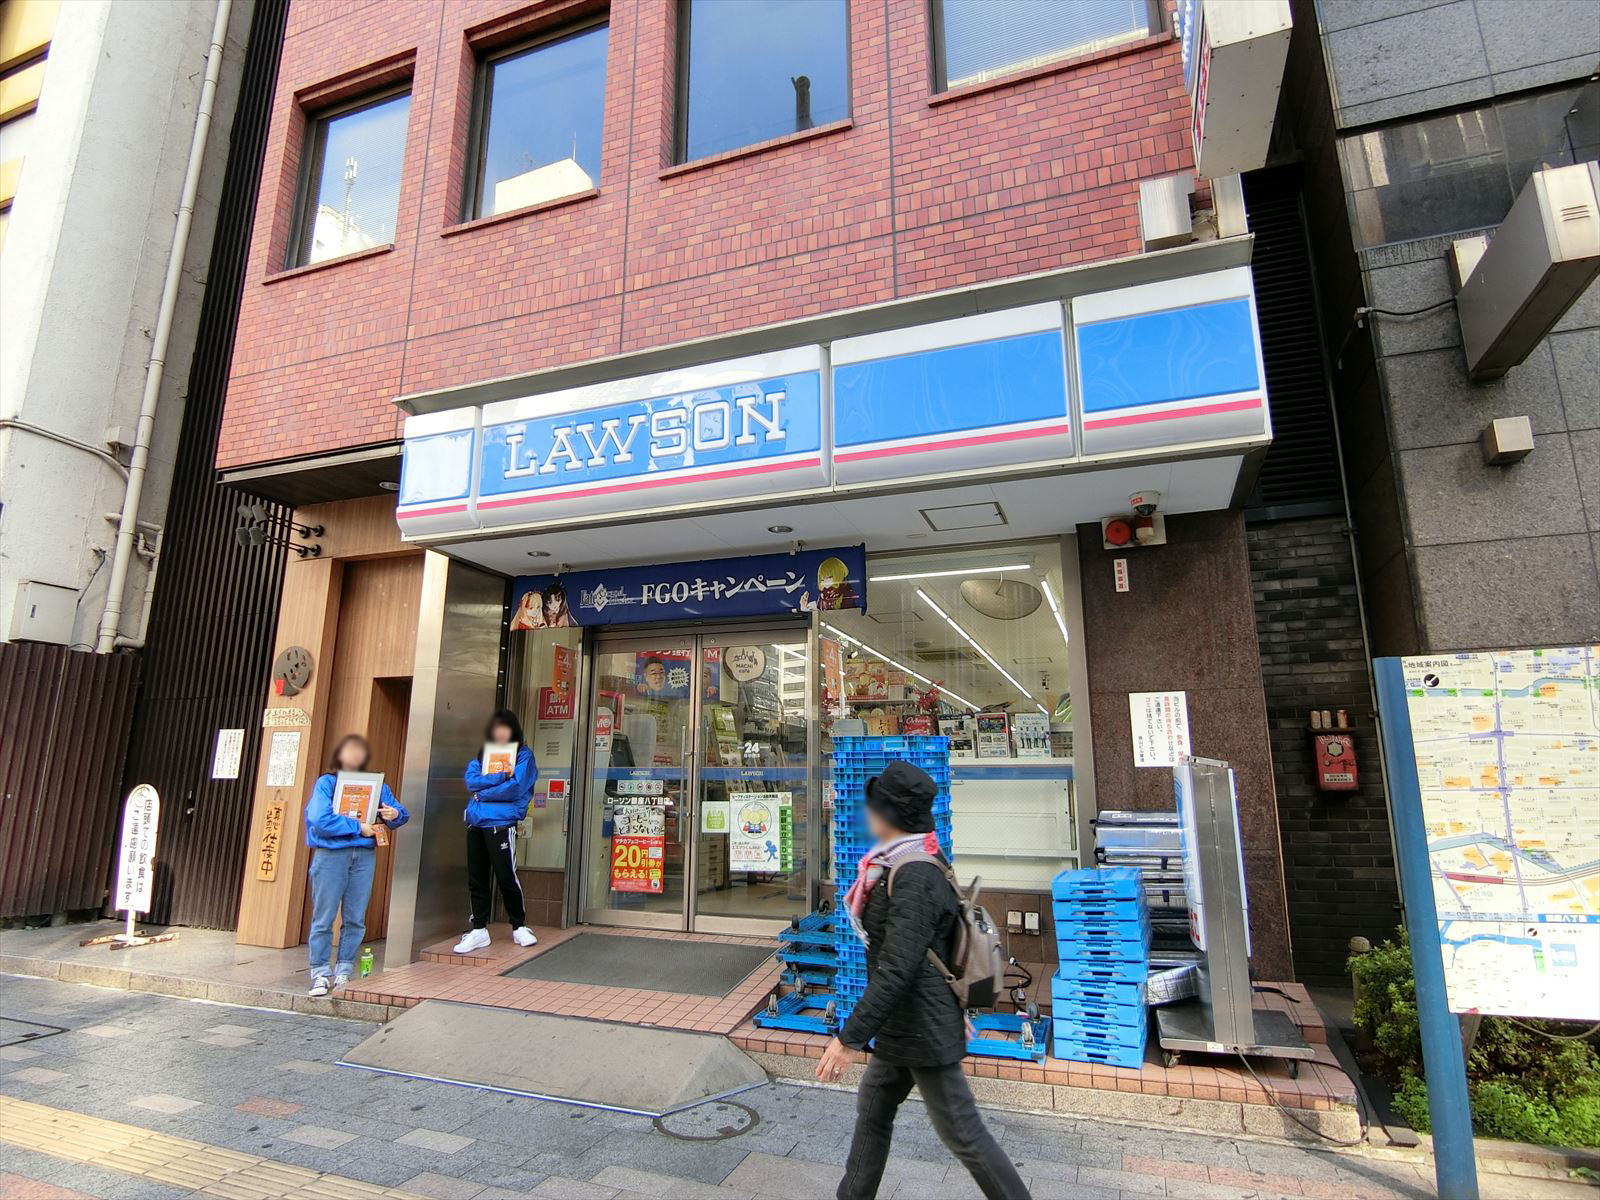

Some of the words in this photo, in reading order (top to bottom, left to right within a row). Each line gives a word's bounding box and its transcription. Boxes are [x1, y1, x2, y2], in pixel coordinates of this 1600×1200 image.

[503, 390, 787, 481] LAWSON
[640, 571, 806, 607] FGOキャンペーン
[1407, 660, 1449, 669] 地域案内図
[546, 705, 569, 716] ATM
[744, 742, 760, 753] 24
